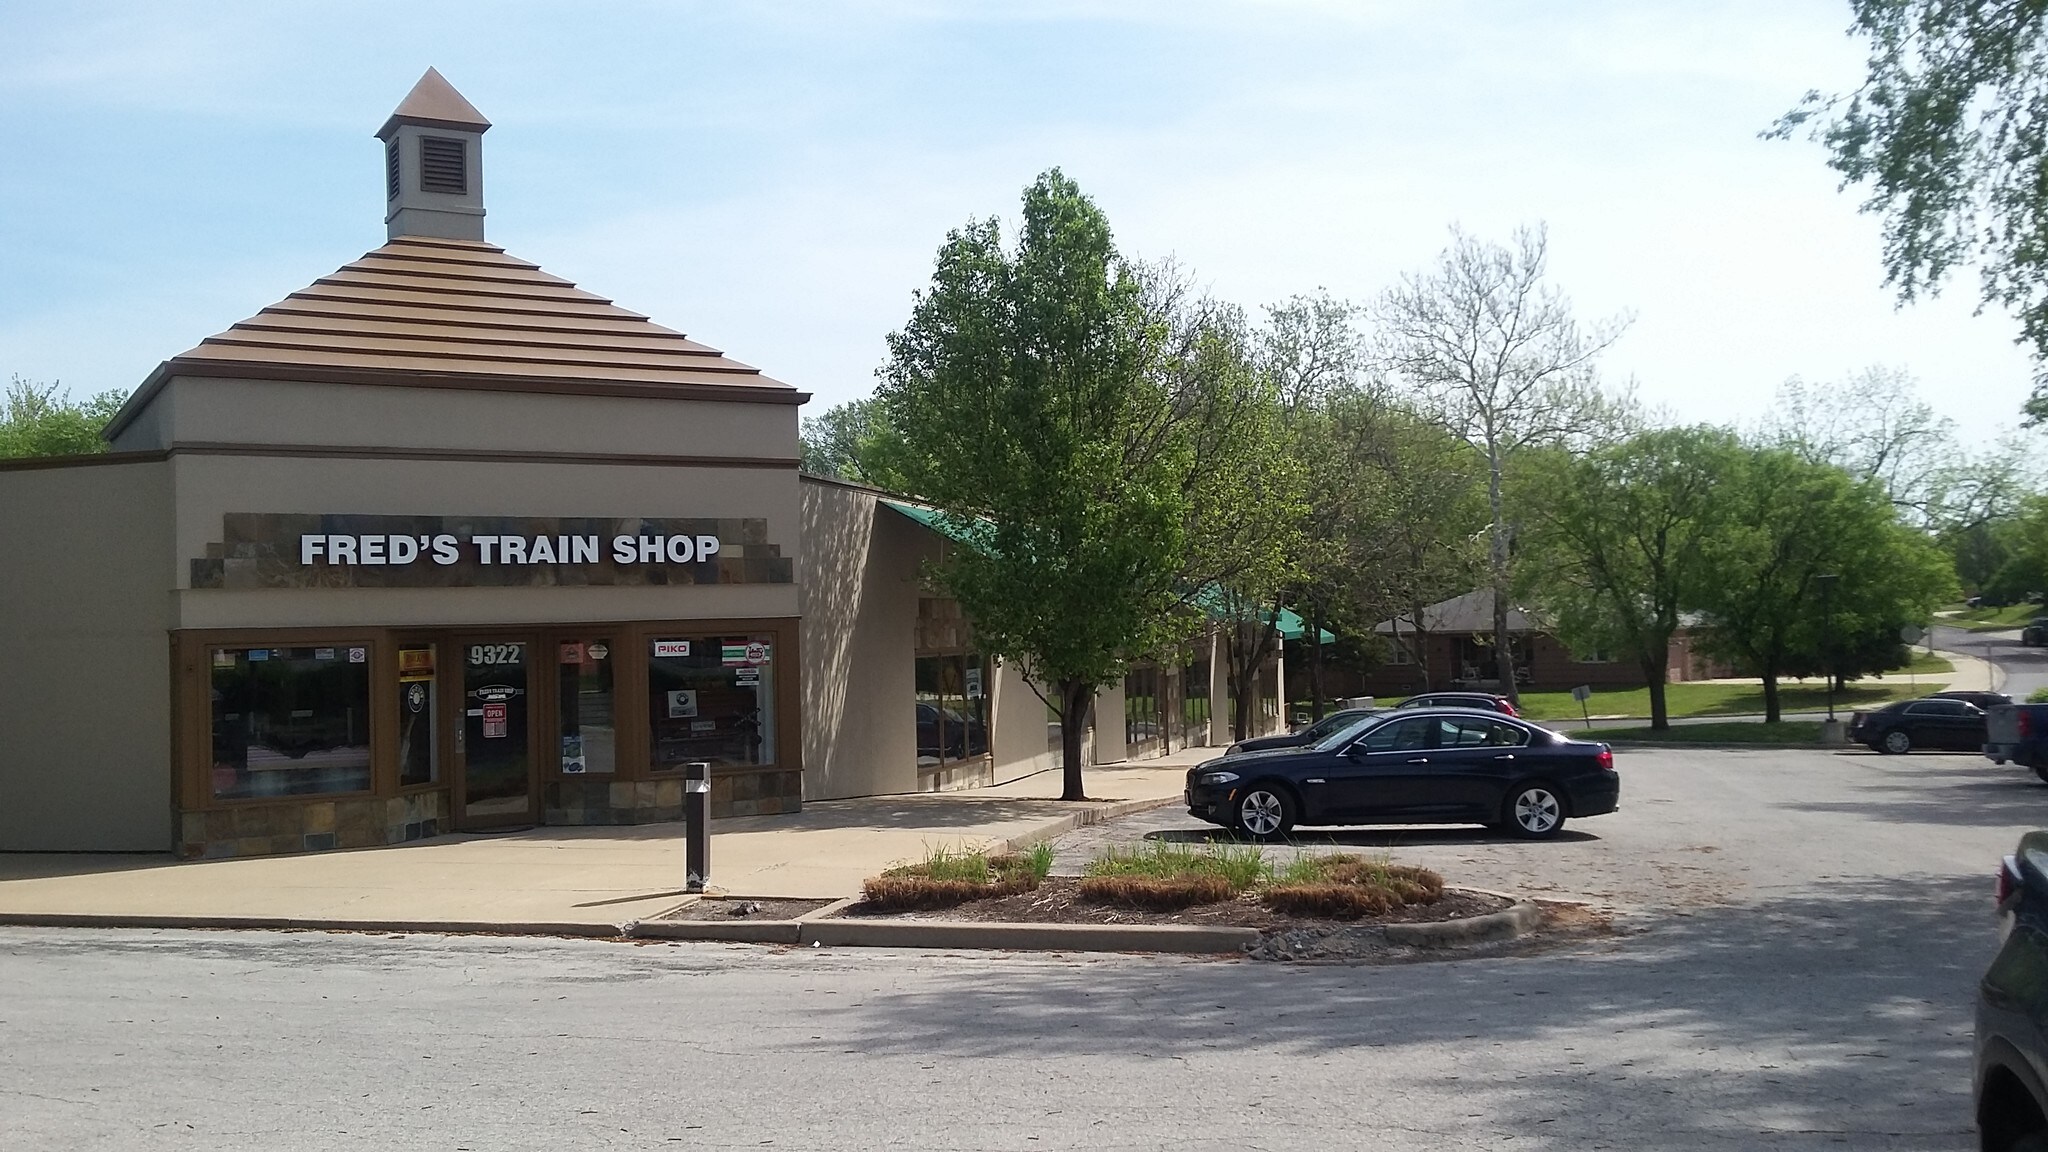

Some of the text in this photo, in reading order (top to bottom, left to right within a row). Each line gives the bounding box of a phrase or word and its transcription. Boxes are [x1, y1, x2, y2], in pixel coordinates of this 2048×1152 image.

[301, 534, 720, 566] FRED'S TRAIN SHOP
[471, 645, 520, 665] 9322
[658, 645, 687, 653] PIKO
[487, 709, 503, 717] OPEN
